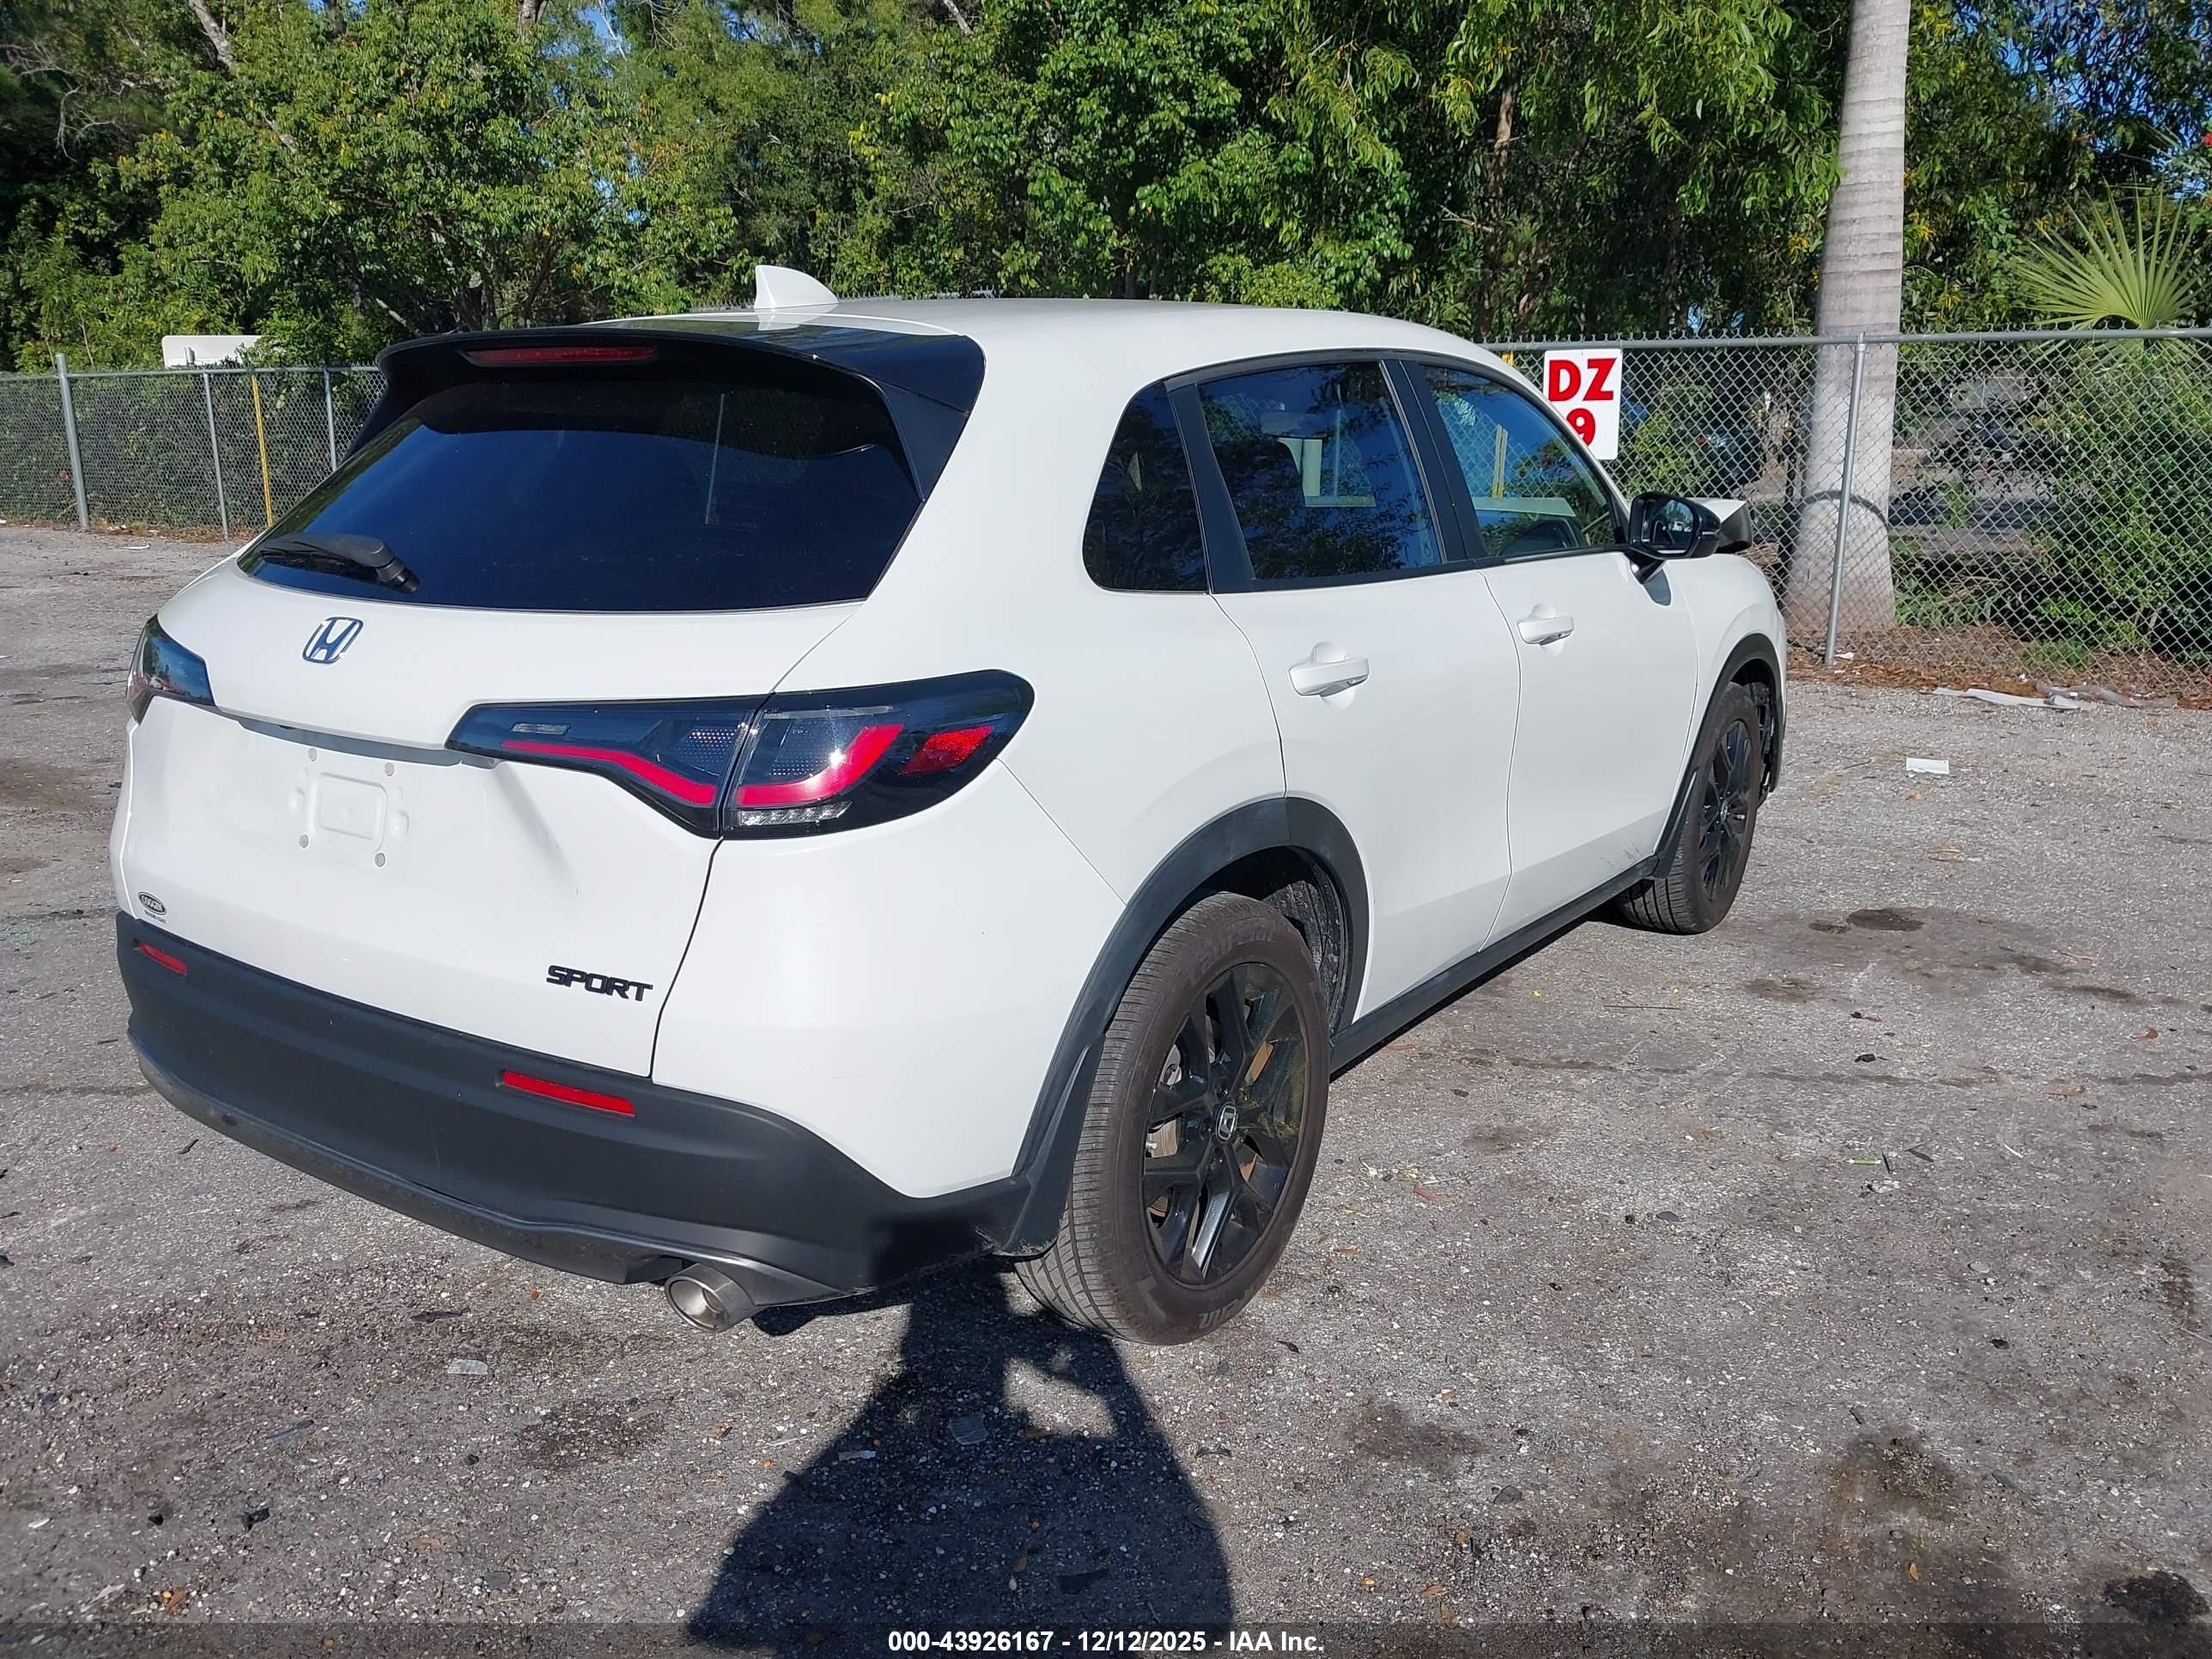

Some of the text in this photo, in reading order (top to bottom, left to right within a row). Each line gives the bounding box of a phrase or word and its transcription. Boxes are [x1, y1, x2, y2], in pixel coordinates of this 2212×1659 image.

[1548, 357, 1617, 402] DZ
[1566, 408, 1595, 447] 9
[546, 965, 653, 1001] SPORT
